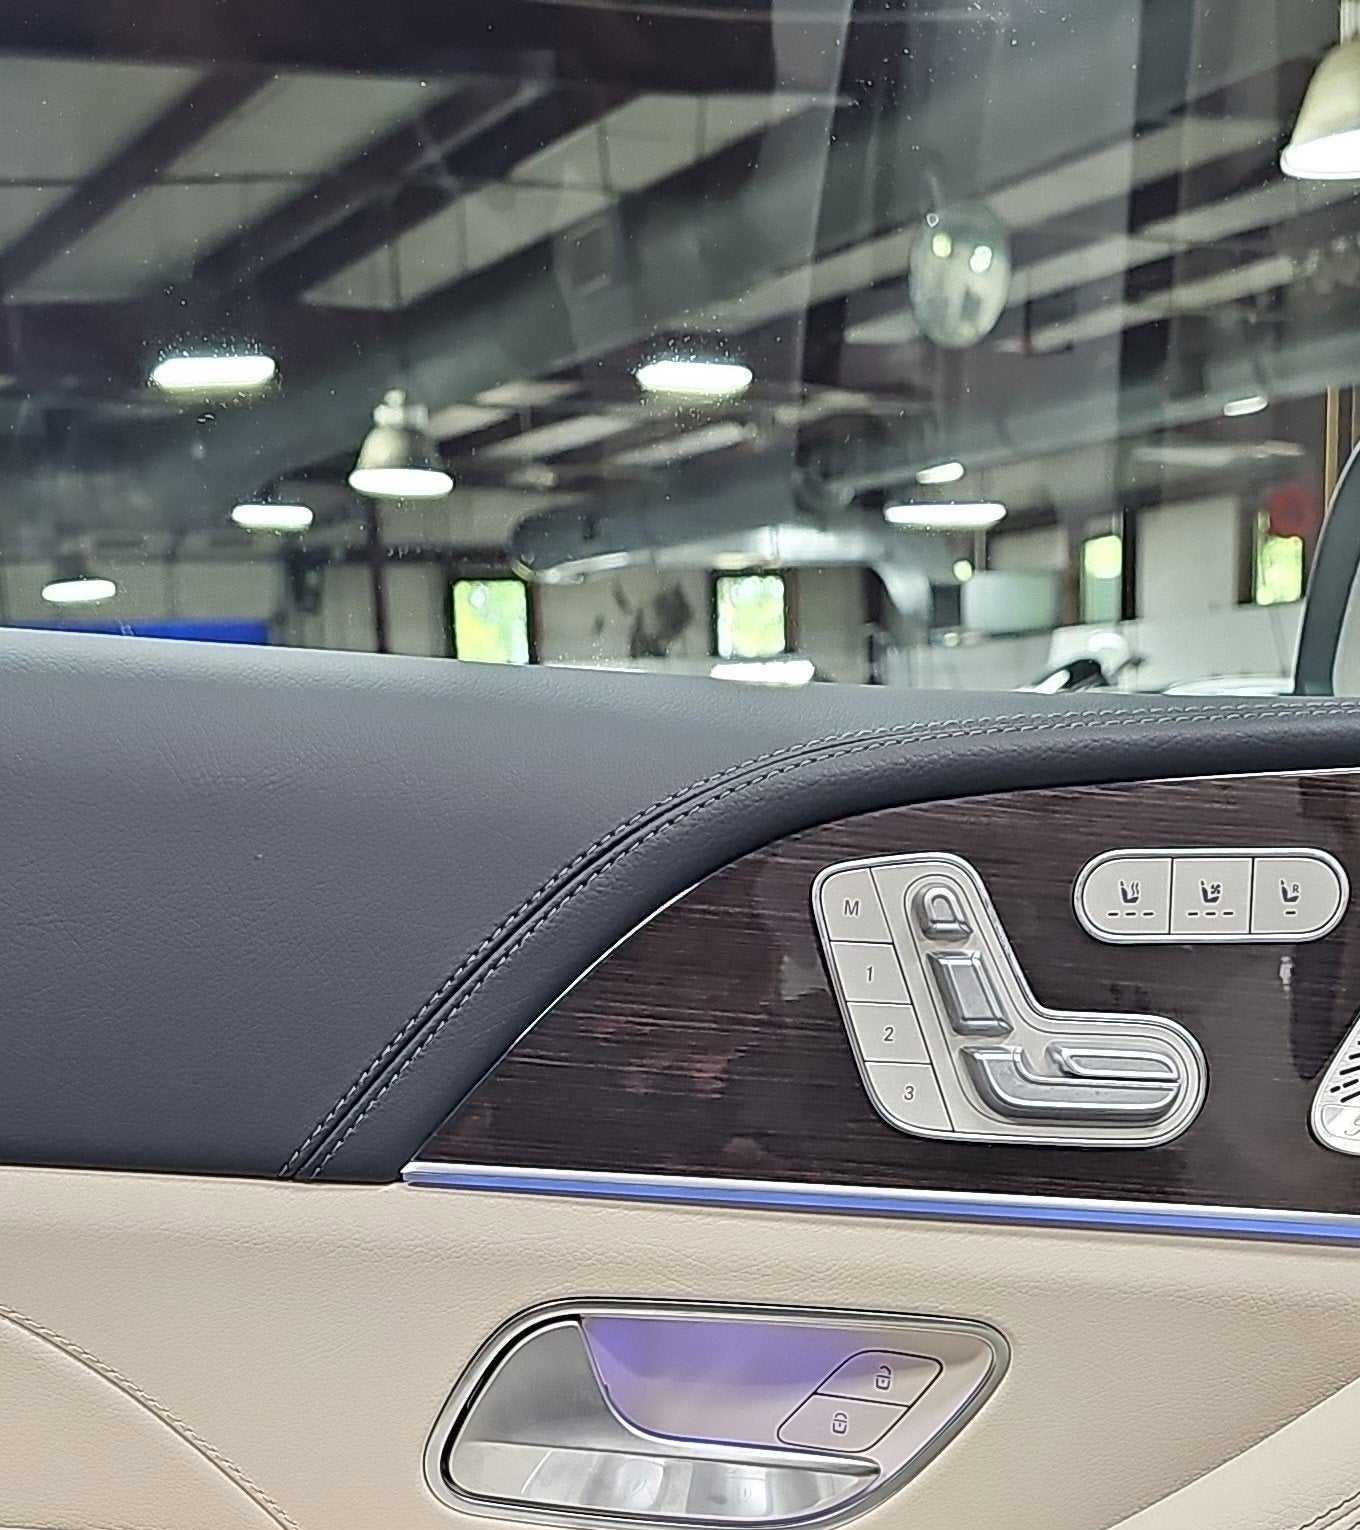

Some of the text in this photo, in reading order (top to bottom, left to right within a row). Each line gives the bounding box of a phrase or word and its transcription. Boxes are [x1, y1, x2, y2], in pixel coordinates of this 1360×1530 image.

[844, 899, 860, 917] M
[866, 965, 873, 982] 1
[883, 1026, 895, 1042] 2
[903, 1085, 915, 1101] 3
